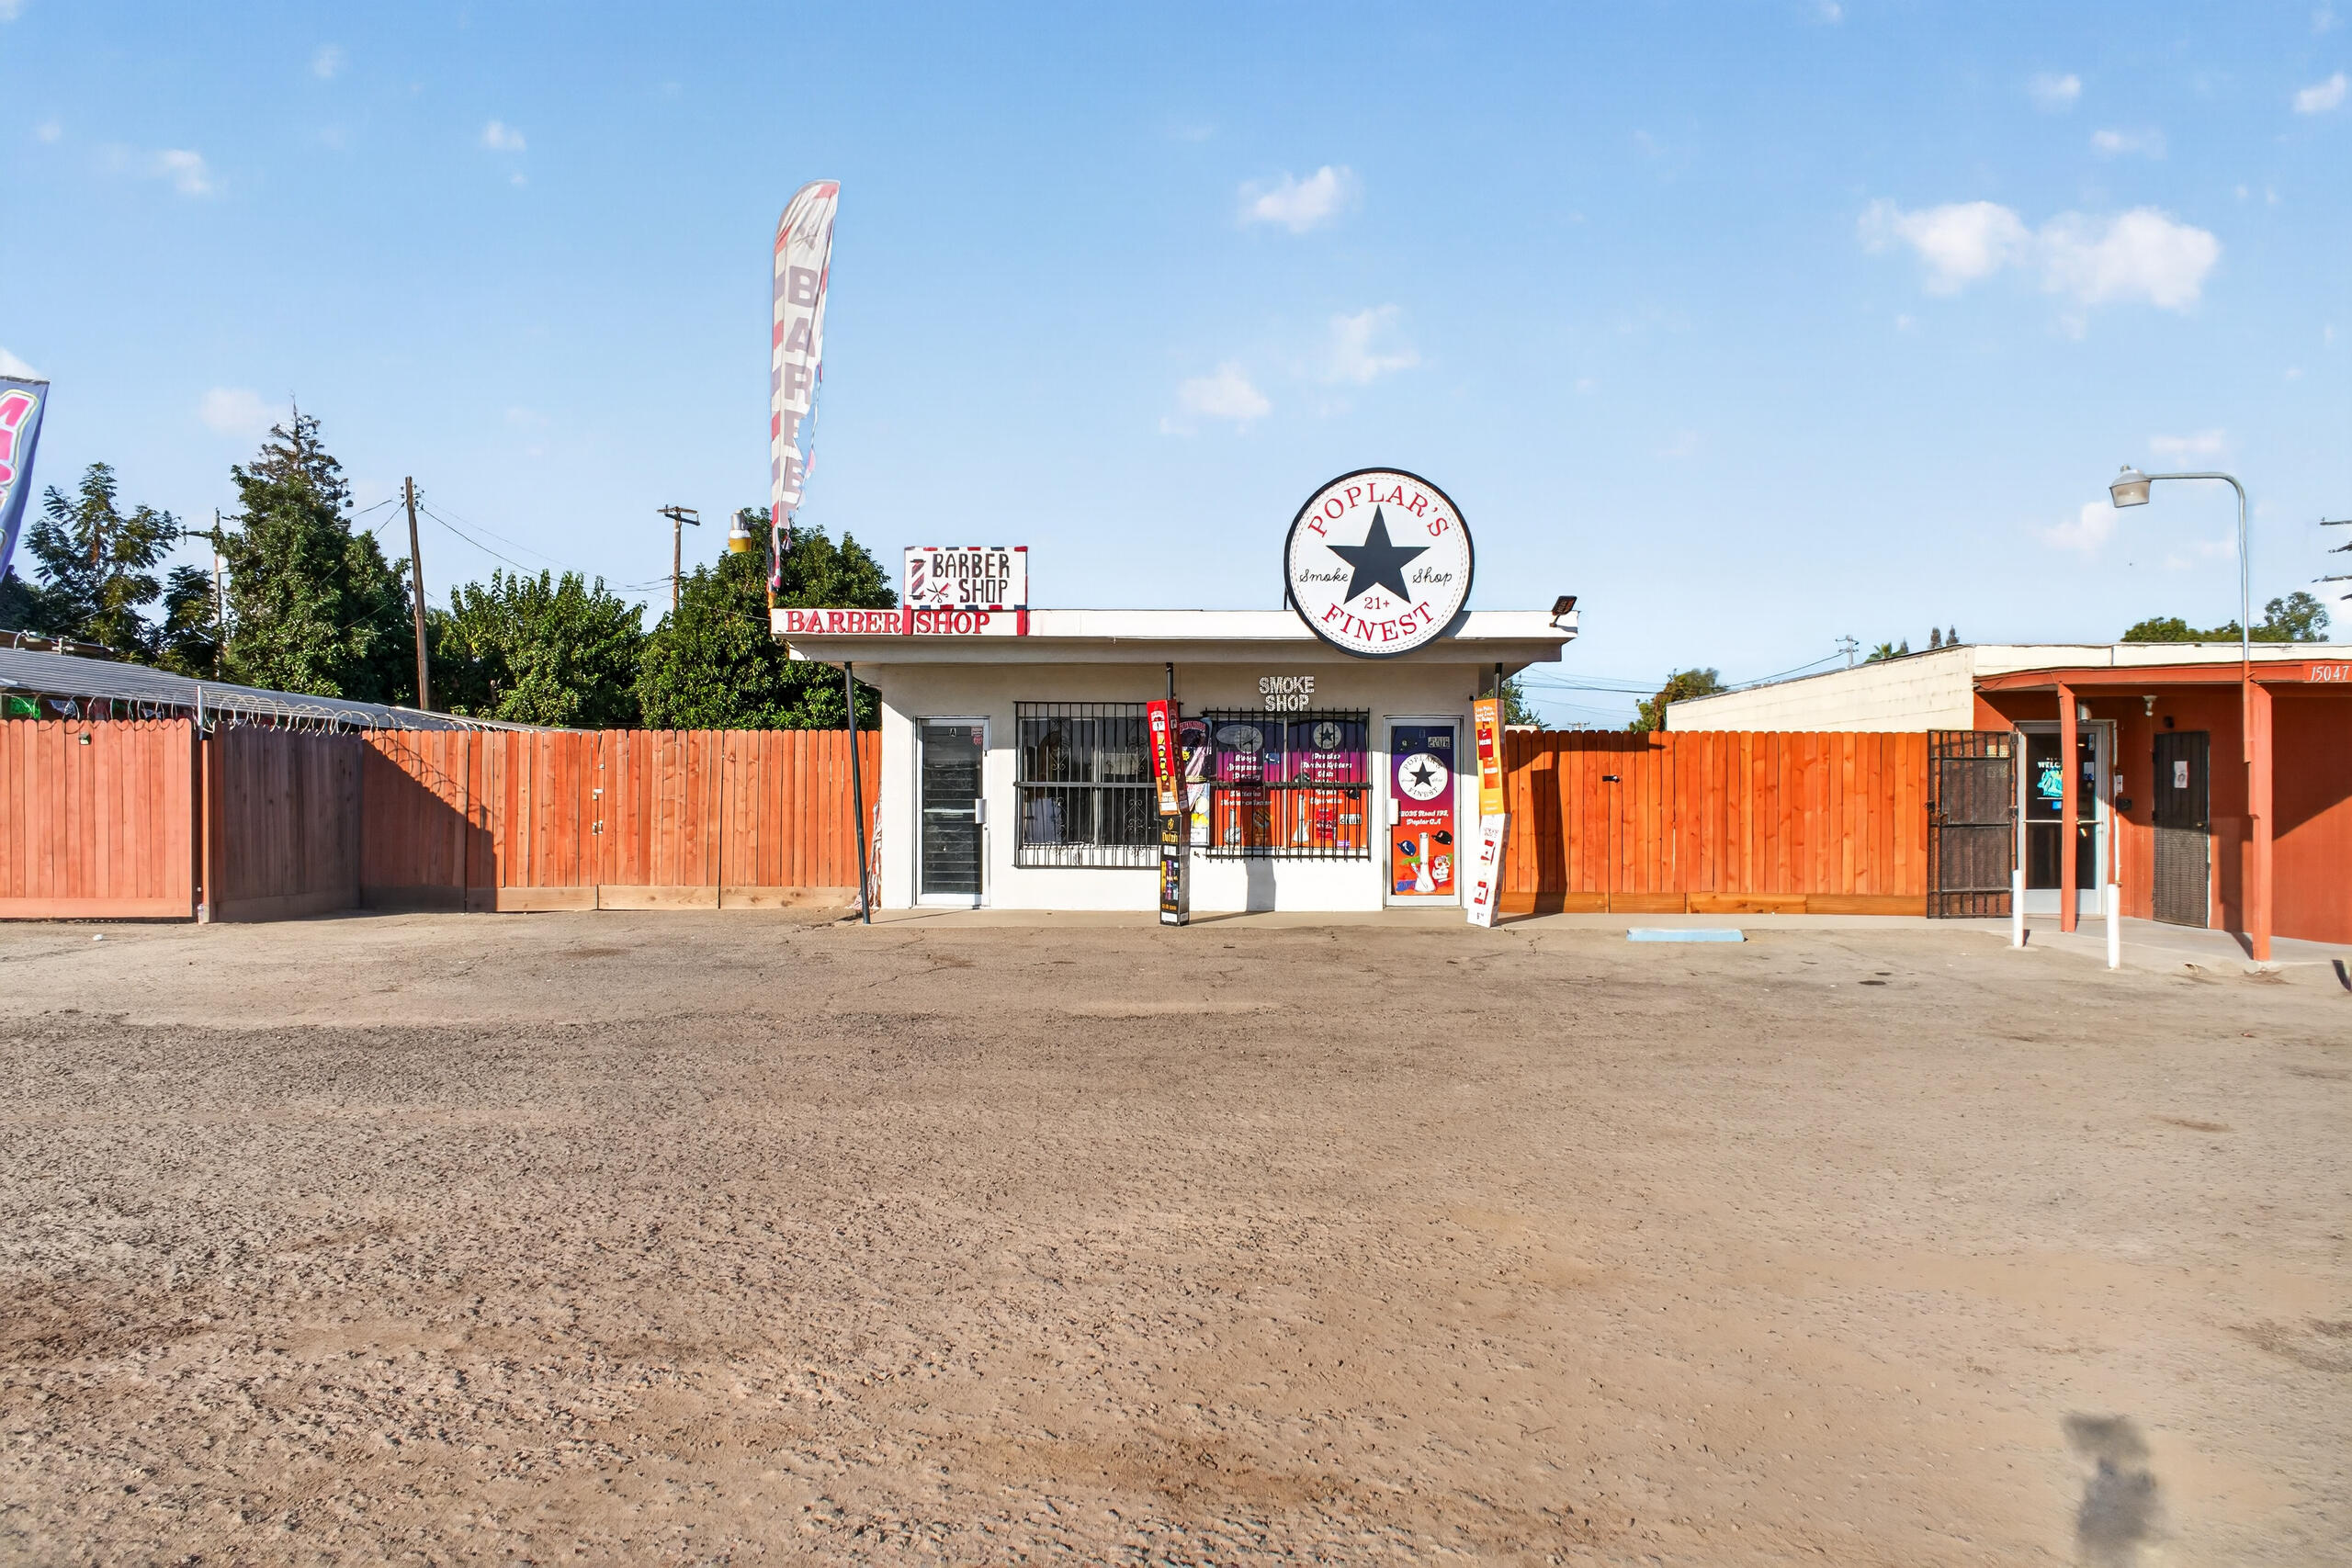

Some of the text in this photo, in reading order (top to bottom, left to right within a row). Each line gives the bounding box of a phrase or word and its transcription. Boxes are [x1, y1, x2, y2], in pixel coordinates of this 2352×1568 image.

[1308, 482, 1449, 537] POPLAR'S
[932, 553, 1010, 578] BARBER
[1299, 567, 1453, 587] Smoke Shop
[959, 579, 1008, 604] SHOP
[1364, 597, 1390, 610] 21+
[786, 610, 990, 635] BARBER SHOP
[1321, 602, 1434, 642] FINEST
[2310, 665, 2349, 682] 15047
[1259, 676, 1315, 694] SMOKE
[1265, 694, 1309, 712] SHOP
